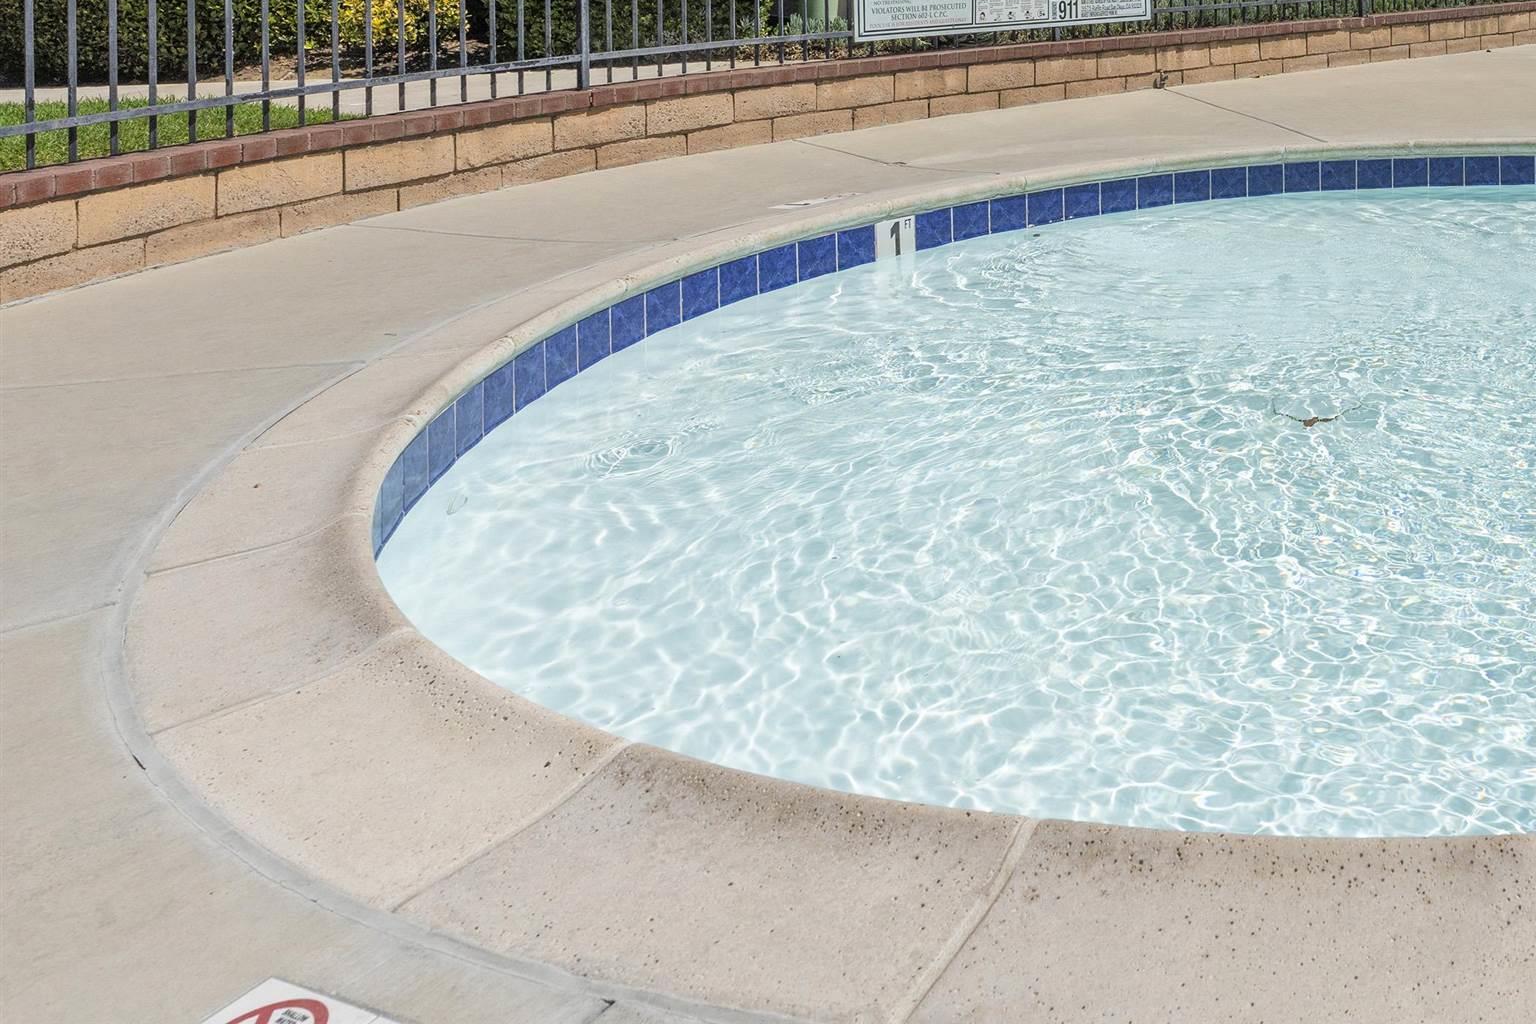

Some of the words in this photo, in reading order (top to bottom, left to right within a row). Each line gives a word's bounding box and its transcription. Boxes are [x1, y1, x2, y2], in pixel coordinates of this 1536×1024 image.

[871, 6, 905, 15] VIOLATORS
[905, 5, 920, 13] WILL
[921, 4, 928, 12] BE
[929, 2, 967, 12] PROSECUTED
[891, 12, 917, 21] SECTION
[1059, 0, 1079, 20] 911
[890, 221, 901, 256] 1
[904, 218, 912, 229] FT
